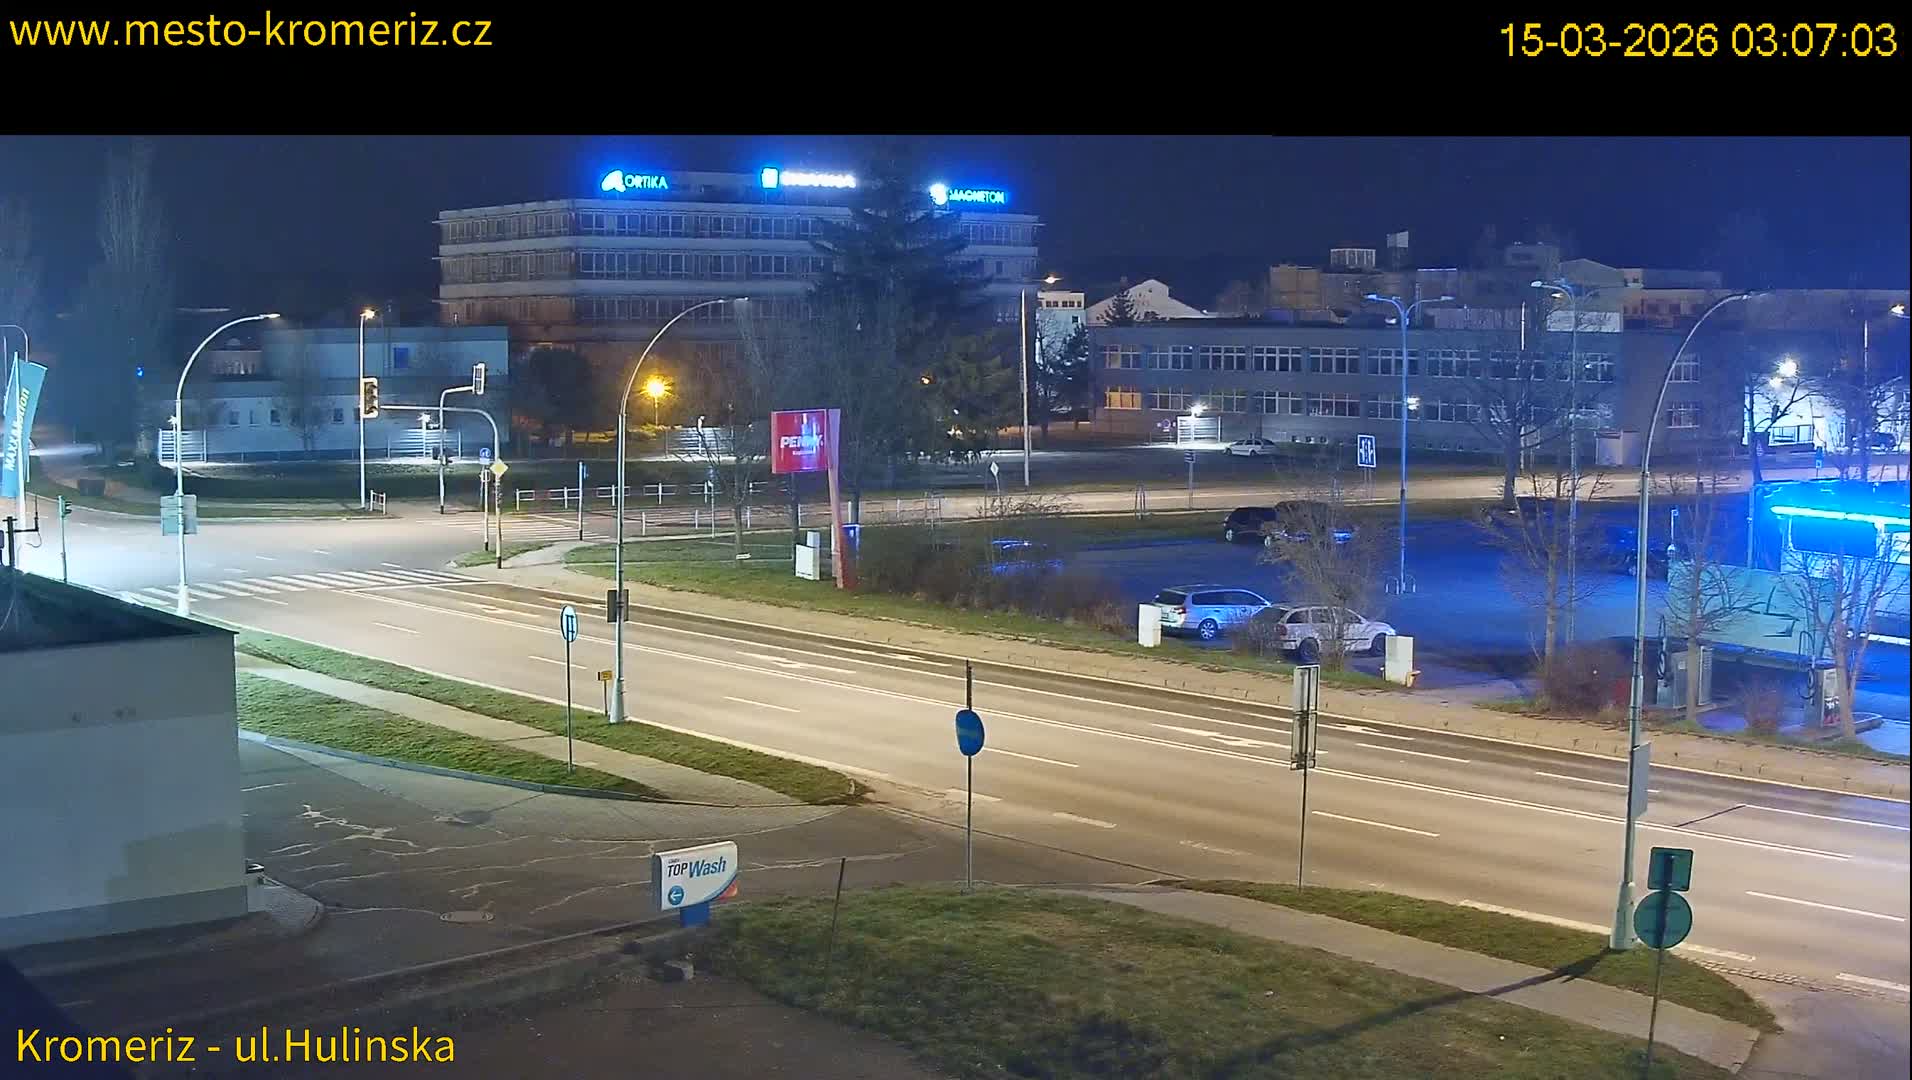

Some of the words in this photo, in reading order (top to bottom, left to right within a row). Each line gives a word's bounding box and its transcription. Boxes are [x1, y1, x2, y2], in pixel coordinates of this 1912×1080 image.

[624, 174, 669, 189] ORTIKA
[949, 188, 1005, 204] MAGNETON
[668, 862, 688, 878] TOP
[689, 856, 727, 878] Wash
